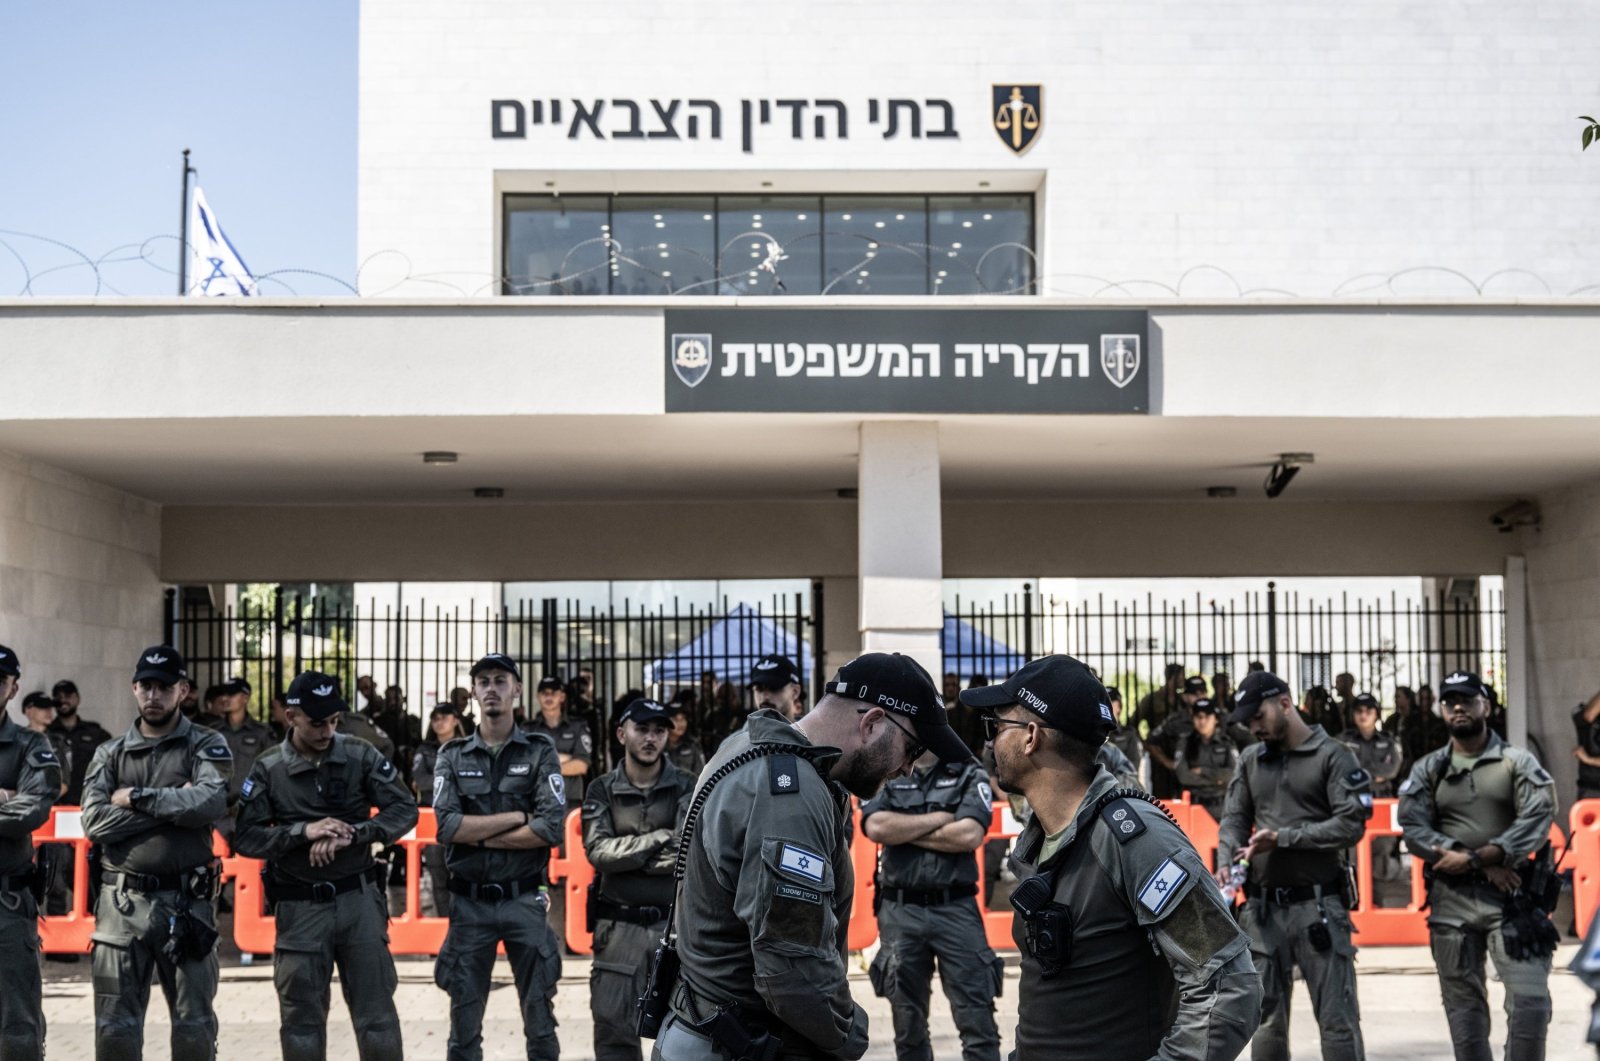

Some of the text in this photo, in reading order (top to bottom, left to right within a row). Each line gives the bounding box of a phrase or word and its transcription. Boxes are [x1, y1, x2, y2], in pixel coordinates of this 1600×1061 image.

[491, 99, 959, 153] בתי הדין הצבאיים
[721, 343, 1090, 385] הקריה המשפטית
[878, 694, 919, 715] POLICE
[1017, 687, 1048, 714] משטרה
